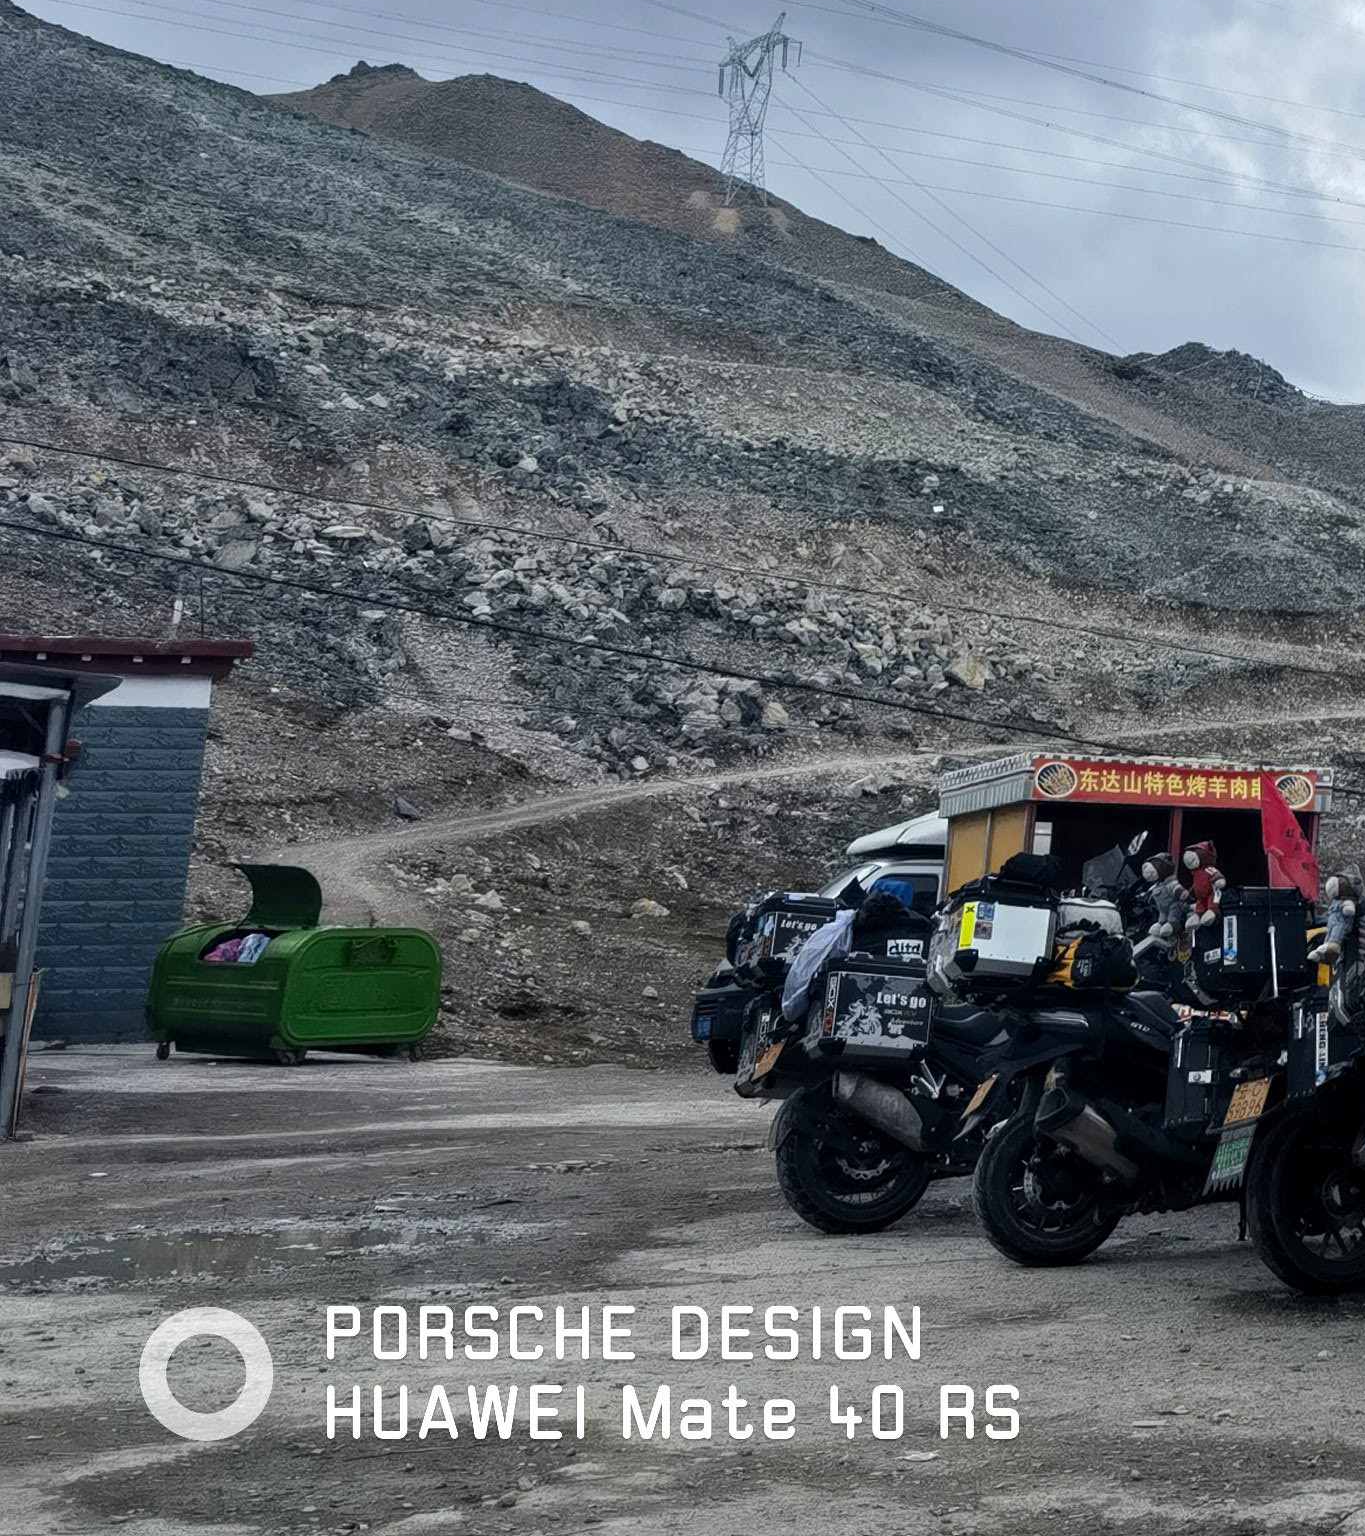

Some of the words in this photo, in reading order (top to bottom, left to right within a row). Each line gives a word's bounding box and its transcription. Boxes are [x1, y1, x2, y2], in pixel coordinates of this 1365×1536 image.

[1079, 768, 1261, 800] 东达山特色烤羊肉串
[876, 991, 908, 1007] Let's
[908, 995, 927, 1009] go
